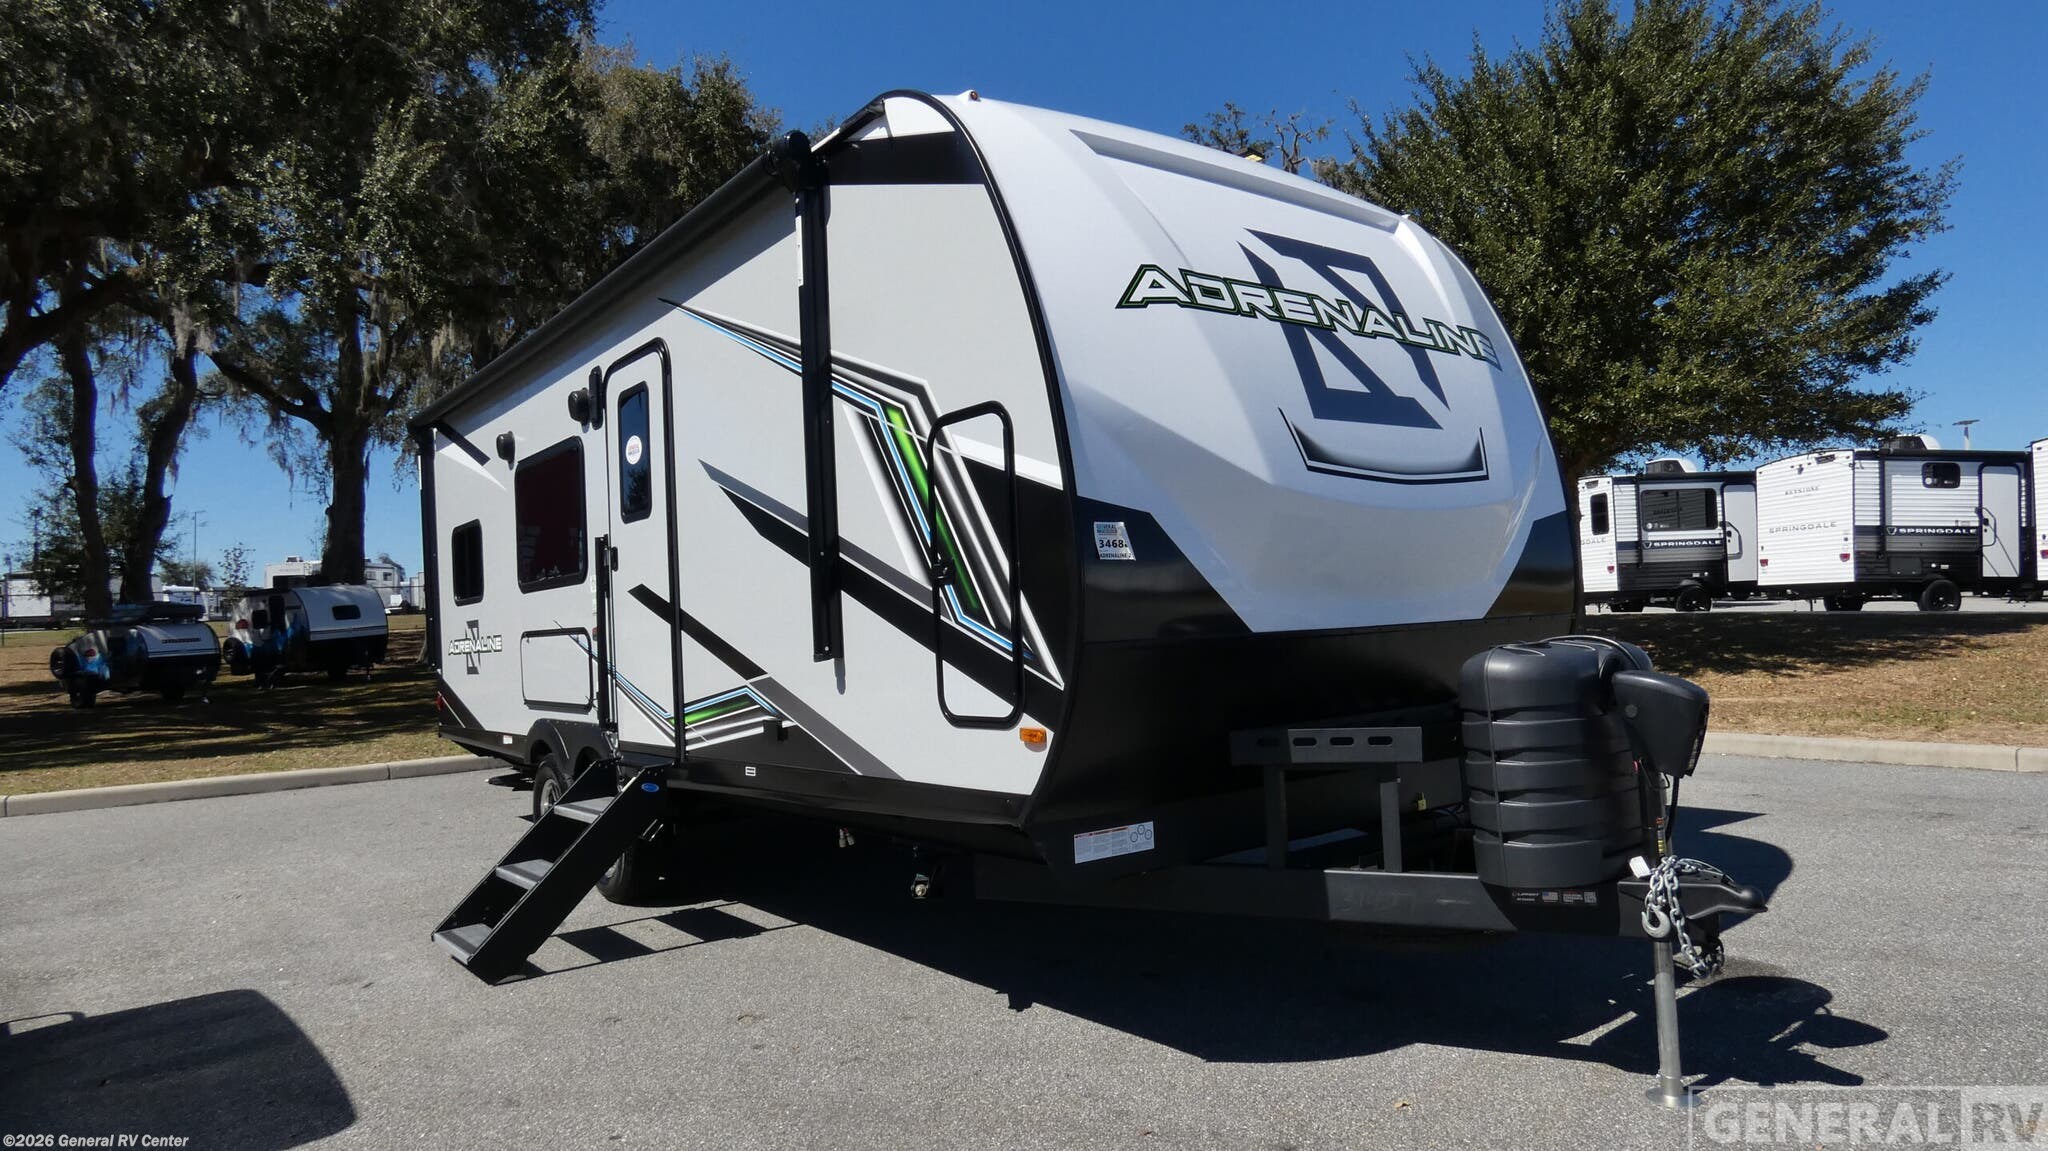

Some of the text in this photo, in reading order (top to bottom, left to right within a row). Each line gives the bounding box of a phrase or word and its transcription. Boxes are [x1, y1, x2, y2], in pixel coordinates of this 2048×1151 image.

[1116, 264, 1502, 371] ADRENALINE
[1768, 521, 1837, 534] SPRINGDALE
[448, 634, 503, 656] ADRENALINE
